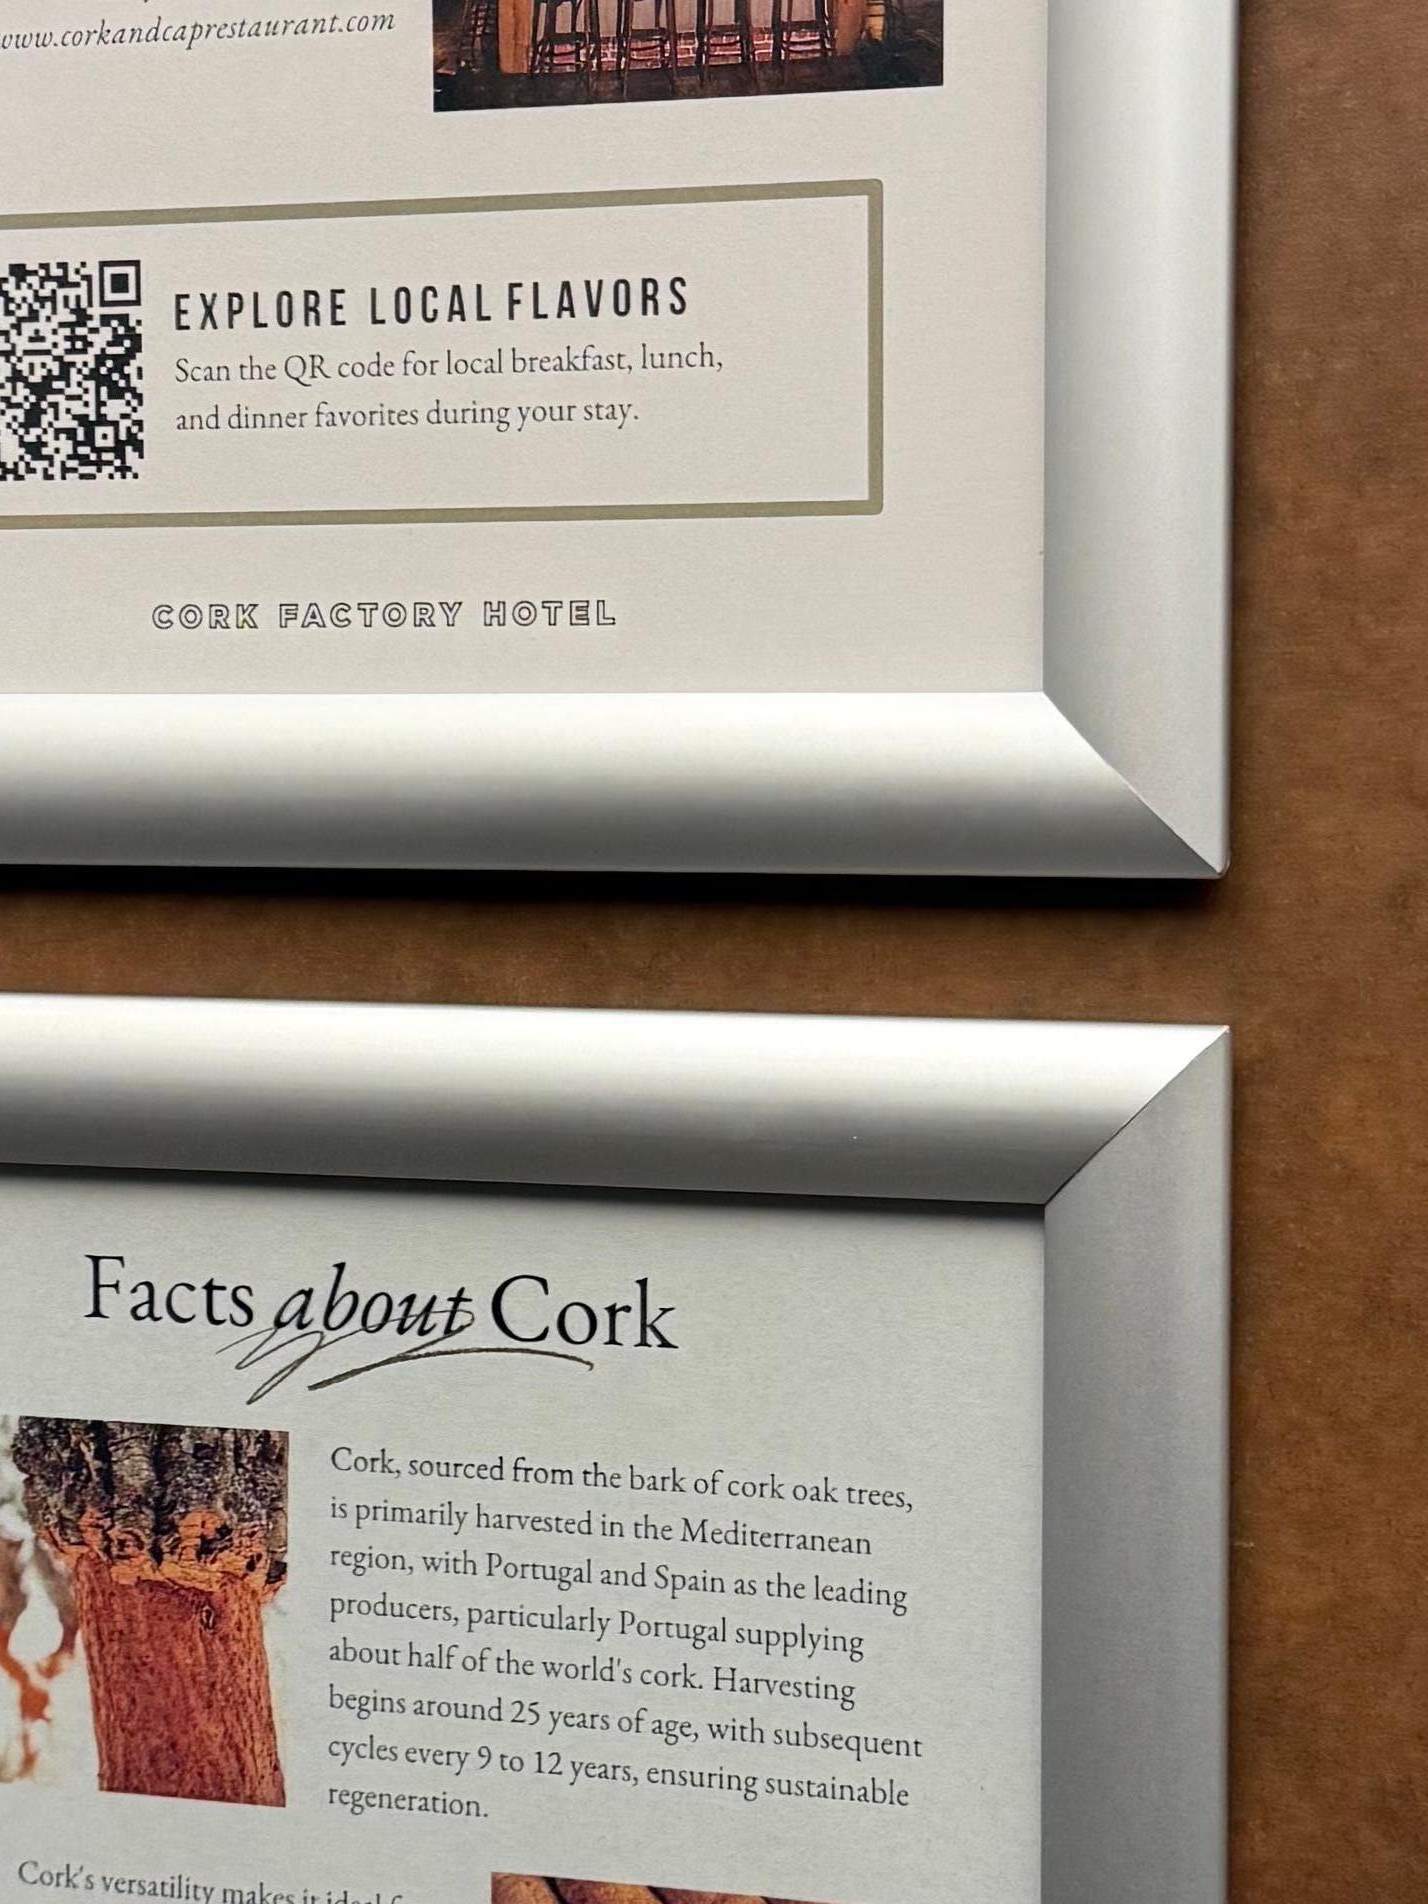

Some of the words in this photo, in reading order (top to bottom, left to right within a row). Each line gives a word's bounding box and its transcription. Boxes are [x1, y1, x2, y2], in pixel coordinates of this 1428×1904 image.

[174, 288, 346, 331] EXPLORE
[370, 283, 492, 325] LOCAL
[508, 276, 687, 321] FLAVORS
[175, 358, 231, 383] Scan
[239, 355, 276, 380] the
[284, 354, 331, 387] QR
[338, 351, 395, 378] code
[403, 350, 439, 376] for
[446, 348, 503, 375] local
[511, 344, 632, 374] breakfast,
[641, 341, 723, 372] lunch,
[176, 404, 221, 430] and
[228, 403, 308, 429] dinner
[315, 401, 419, 427] favorites
[426, 399, 510, 433] during
[517, 405, 577, 432] your
[584, 403, 638, 430] stay.
[152, 603, 259, 630] CORK
[279, 601, 463, 629] FACTORY
[483, 599, 616, 627] HOTEL
[84, 1254, 255, 1329] Facts
[274, 1262, 473, 1337] about
[492, 1274, 678, 1349] Cork
[330, 1446, 401, 1479] Cork,
[408, 1456, 505, 1481] sourced
[512, 1456, 574, 1485] from
[582, 1461, 622, 1489] the
[629, 1464, 687, 1493] bark
[693, 1469, 724, 1495] of
[727, 1473, 785, 1500] cork
[792, 1476, 839, 1503] oak
[846, 1487, 913, 1513] trees,
[331, 1496, 348, 1519] is
[355, 1499, 468, 1536] primarily
[476, 1503, 593, 1536] harvested
[601, 1513, 624, 1538] in
[633, 1514, 673, 1541] the
[680, 1517, 871, 1555] Mediterranean
[330, 1545, 414, 1577] region,
[421, 1549, 477, 1576] with
[486, 1552, 592, 1591] Portugal
[600, 1562, 647, 1587] and
[654, 1564, 725, 1600] Spain
[734, 1578, 757, 1596] as
[766, 1572, 806, 1599] the
[814, 1574, 907, 1617] leading
[329, 1788, 488, 1818] regeneration.
[18, 1860, 94, 1890] Cork's
